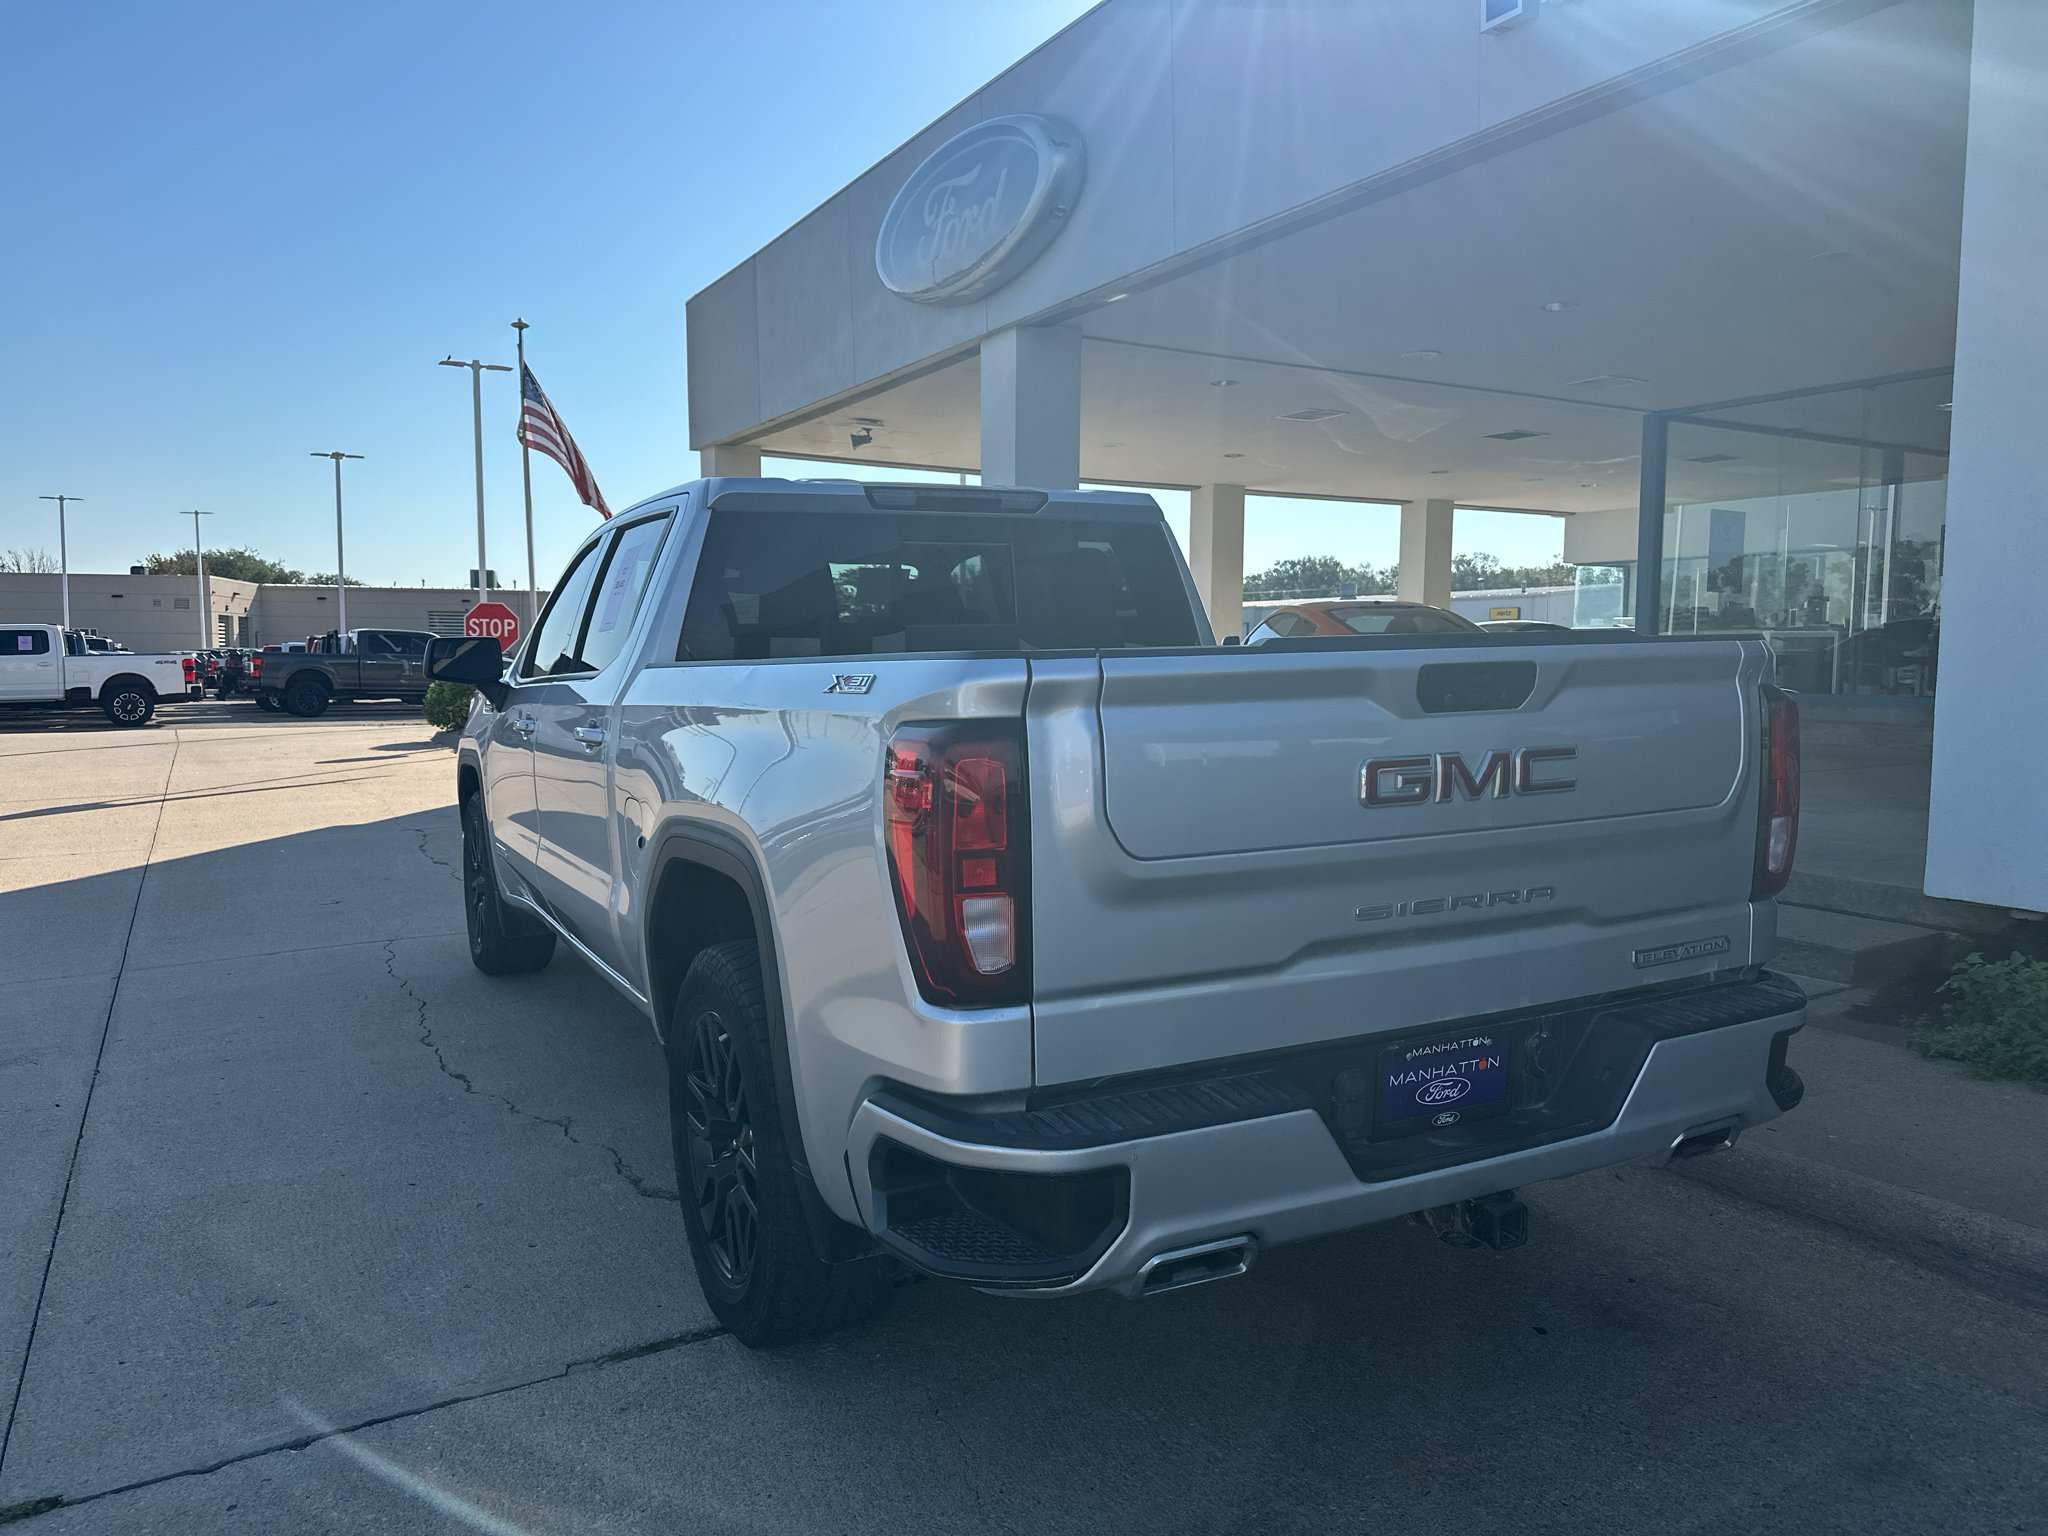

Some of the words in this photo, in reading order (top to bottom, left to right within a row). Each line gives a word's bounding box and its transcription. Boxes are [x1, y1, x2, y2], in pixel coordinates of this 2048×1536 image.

[917, 162, 1009, 268] Ford
[468, 618, 516, 638] STOP
[1359, 744, 1578, 808] GMC
[1355, 885, 1557, 922] SIERRA
[1640, 939, 1724, 963] ELEVATION
[1424, 1081, 1462, 1102] Ford
[1437, 1113, 1455, 1124] Ford
